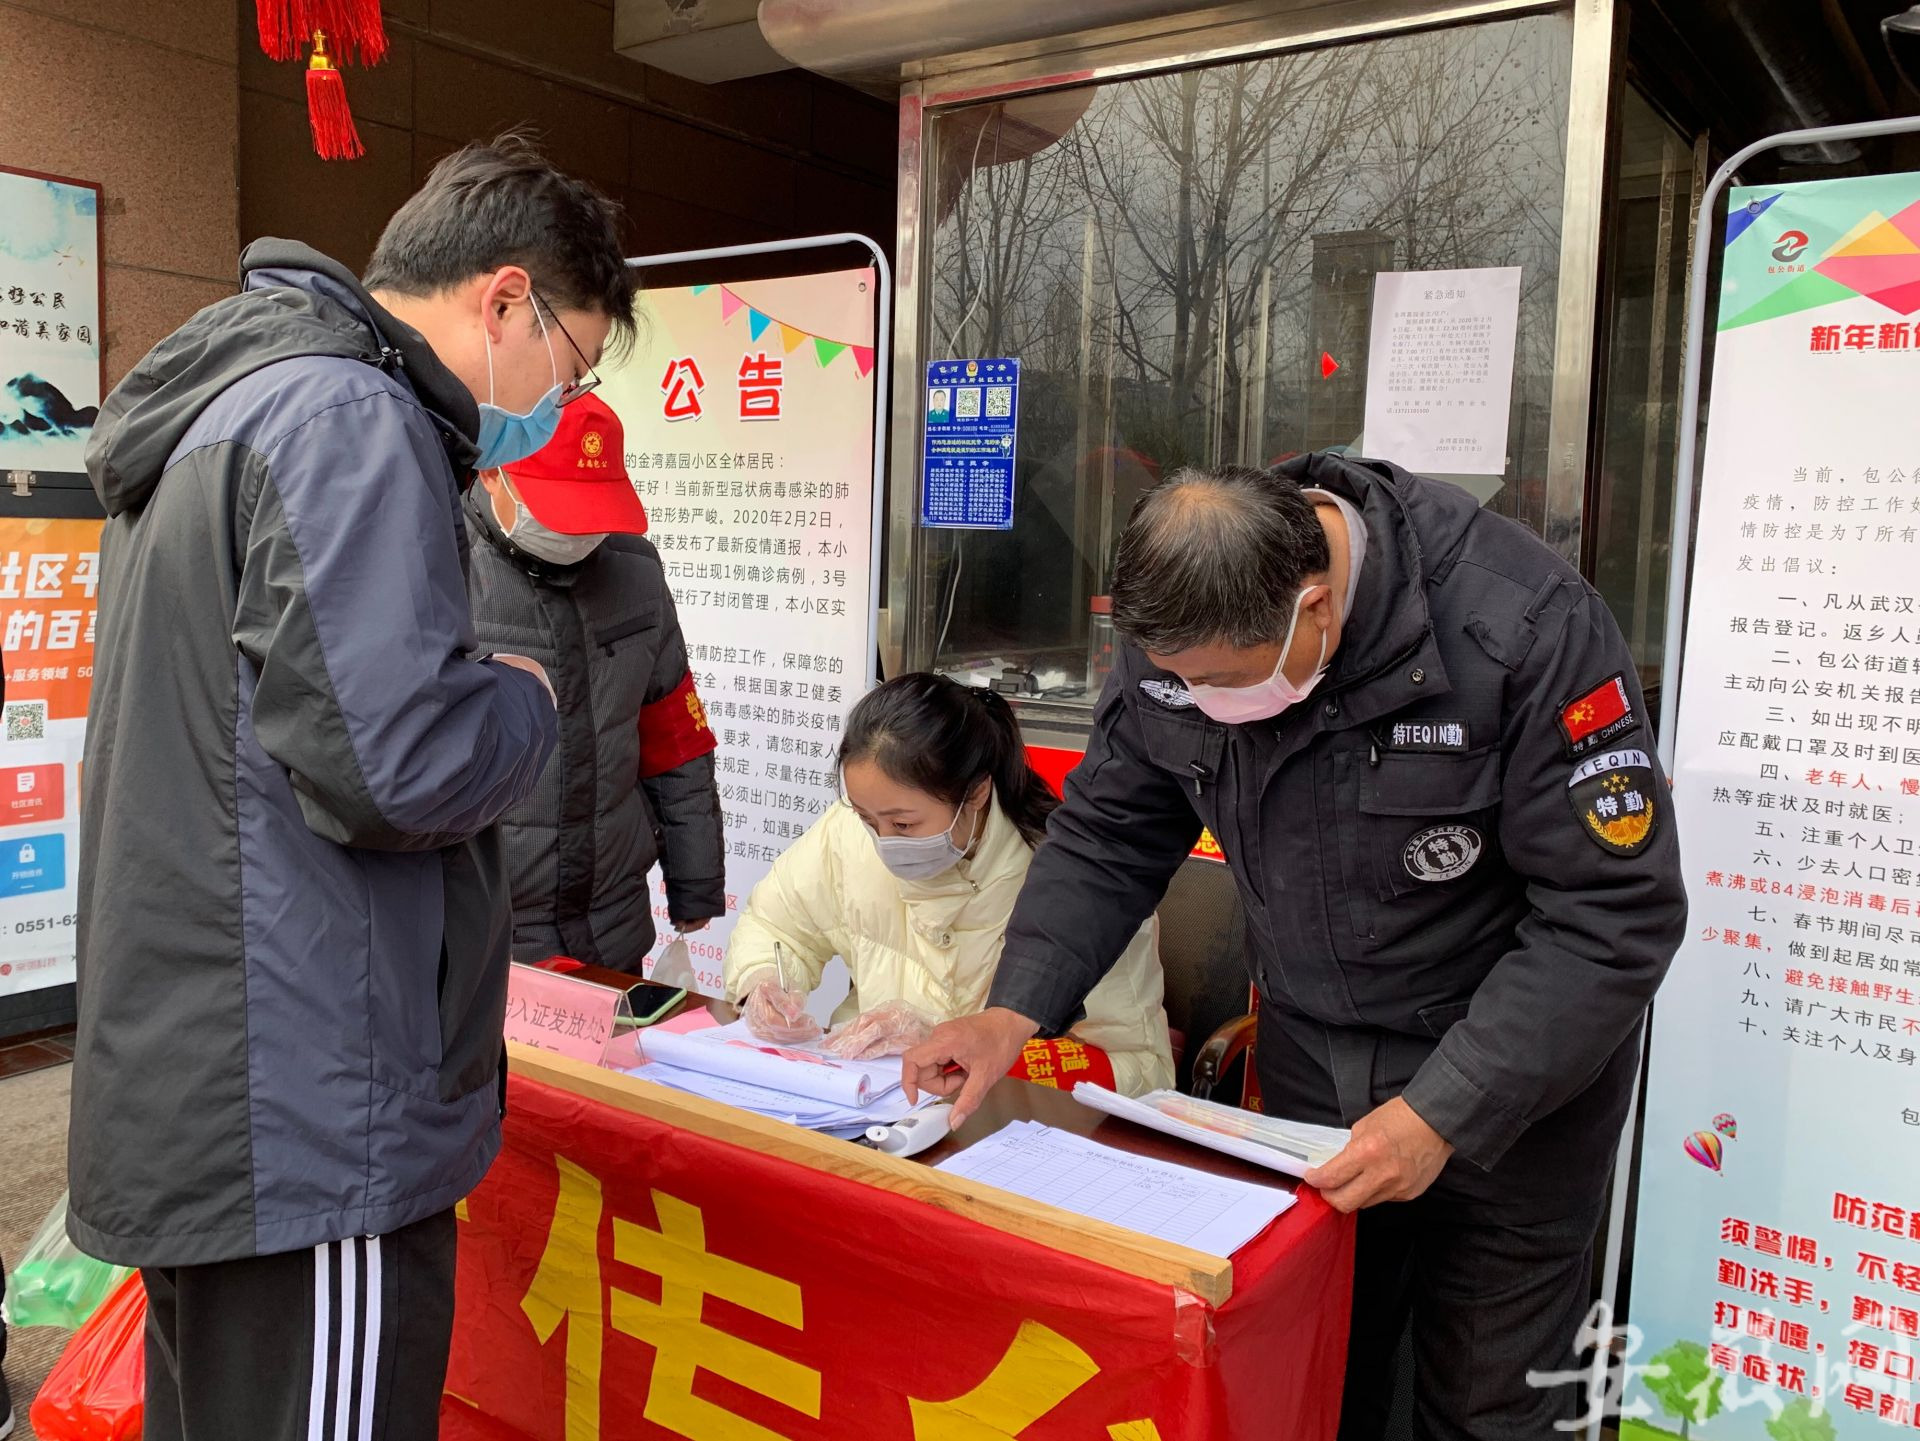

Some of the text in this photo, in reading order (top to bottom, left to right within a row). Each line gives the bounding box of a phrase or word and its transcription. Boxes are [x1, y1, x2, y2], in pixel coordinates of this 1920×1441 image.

[0, 285, 68, 310] 好公民
[1424, 289, 1466, 300] 紧急通知
[1810, 323, 1920, 352] 新年新
[1793, 465, 1920, 484] 当前，包公
[643, 533, 848, 558] 健委发布了最新疫情通报，本小
[1778, 593, 1920, 613] 一、凡从武汉
[1730, 616, 1920, 645] 报告登记。返乡人
[1581, 752, 1641, 777] TEQIN
[1596, 790, 1645, 818] 特勤
[722, 810, 812, 840] 防护，如遇身
[1755, 821, 1920, 857] 五、注重个人卫
[1753, 849, 1920, 887] 六、少去人口密
[1706, 870, 1920, 918] 煮沸或84浸泡消毒后
[1743, 962, 1920, 1006] 八、避免接触野生
[1711, 1343, 1920, 1429] 有症状，早就
